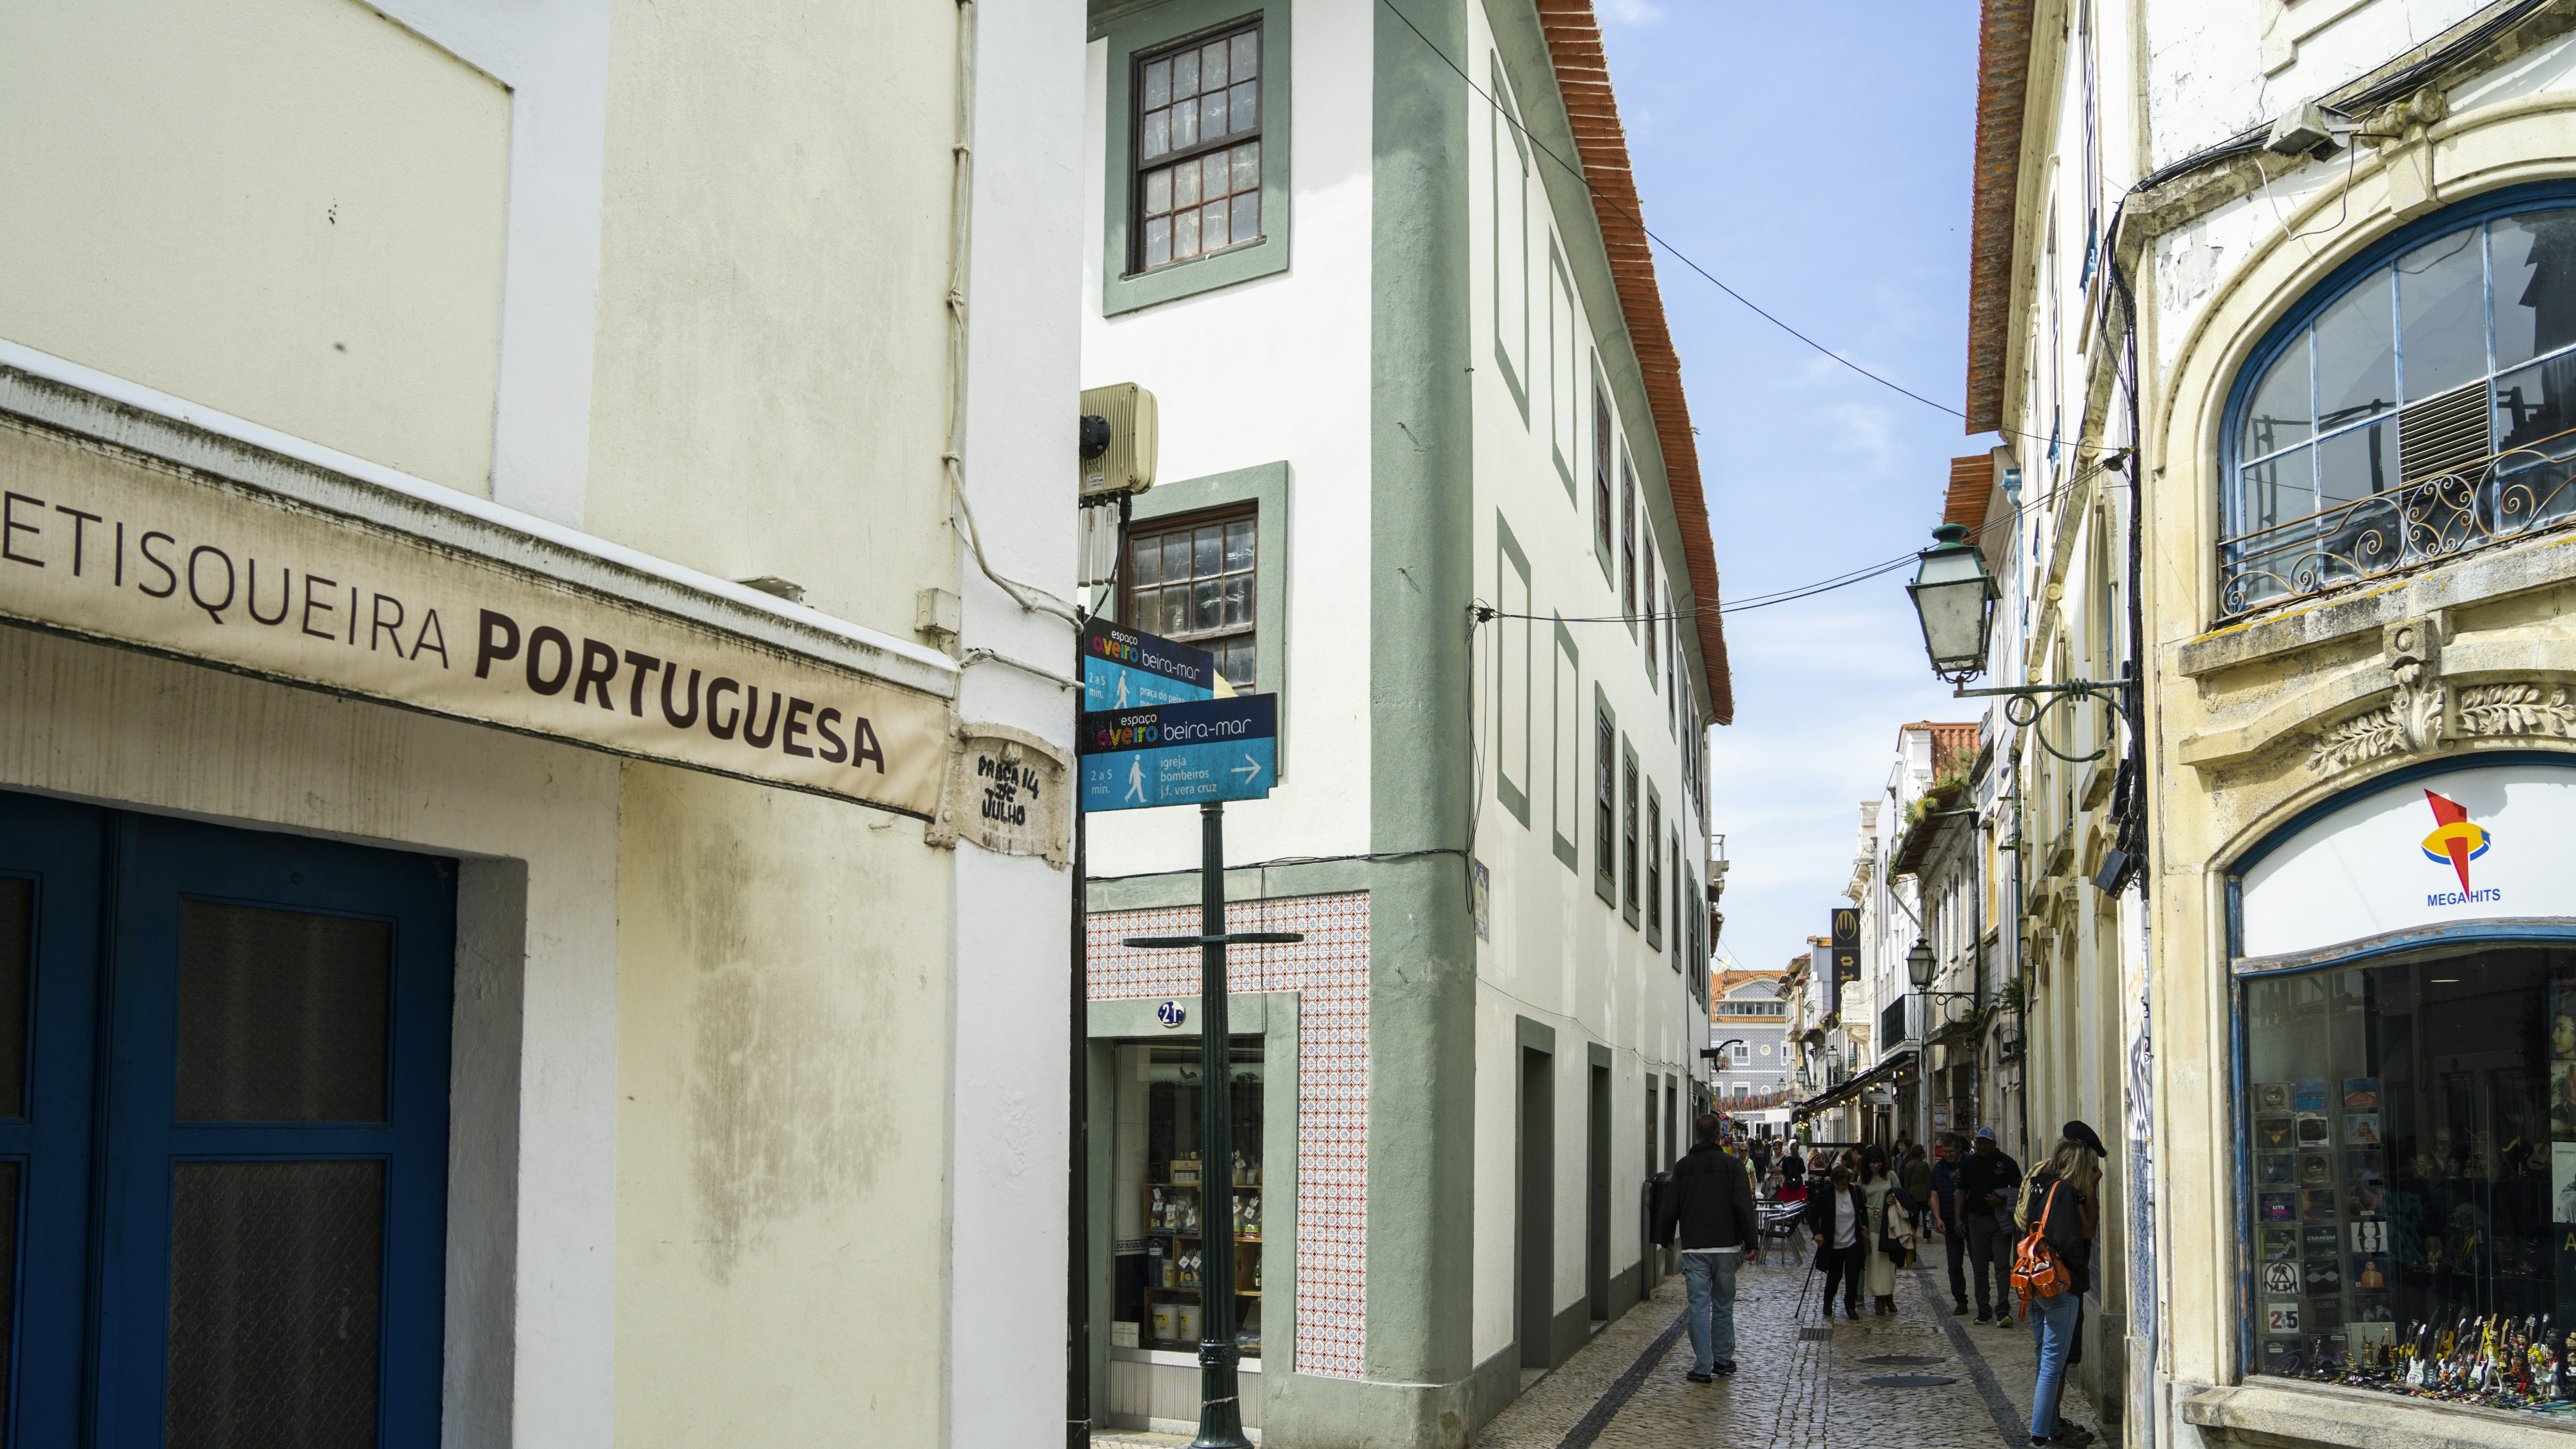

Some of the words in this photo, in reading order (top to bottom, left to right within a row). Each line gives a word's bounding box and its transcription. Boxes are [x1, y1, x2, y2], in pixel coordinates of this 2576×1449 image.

[1112, 630, 1138, 645] espaço
[1093, 636, 1139, 662] aveiro
[1142, 649, 1200, 680] beira-mar
[1089, 672, 1093, 683] 2
[1095, 676, 1099, 684] a
[1101, 675, 1105, 686] 5
[474, 608, 885, 775] PORTUGUESA
[1089, 687, 1103, 699] min.
[1140, 687, 1157, 700] praça
[1159, 690, 1167, 701] do
[1169, 694, 1185, 704] peixe
[1121, 714, 1157, 727] espaço
[1097, 725, 1158, 746] aveiro
[1164, 719, 1252, 741] beira-mar
[1161, 756, 1186, 770] igreja
[1091, 771, 1096, 781] 2
[1108, 769, 1112, 779] 5
[1161, 769, 1209, 782] bombeiros
[1022, 767, 1039, 800] 14
[1091, 785, 1110, 794] min.
[1160, 785, 1172, 799] j.f.
[1175, 786, 1194, 795] vera
[1197, 784, 1217, 793] cruz
[982, 787, 1026, 826] JULHO
[2428, 892, 2467, 906] MEGA
[2470, 889, 2500, 902] HITS
[1163, 1004, 1176, 1022] 21
